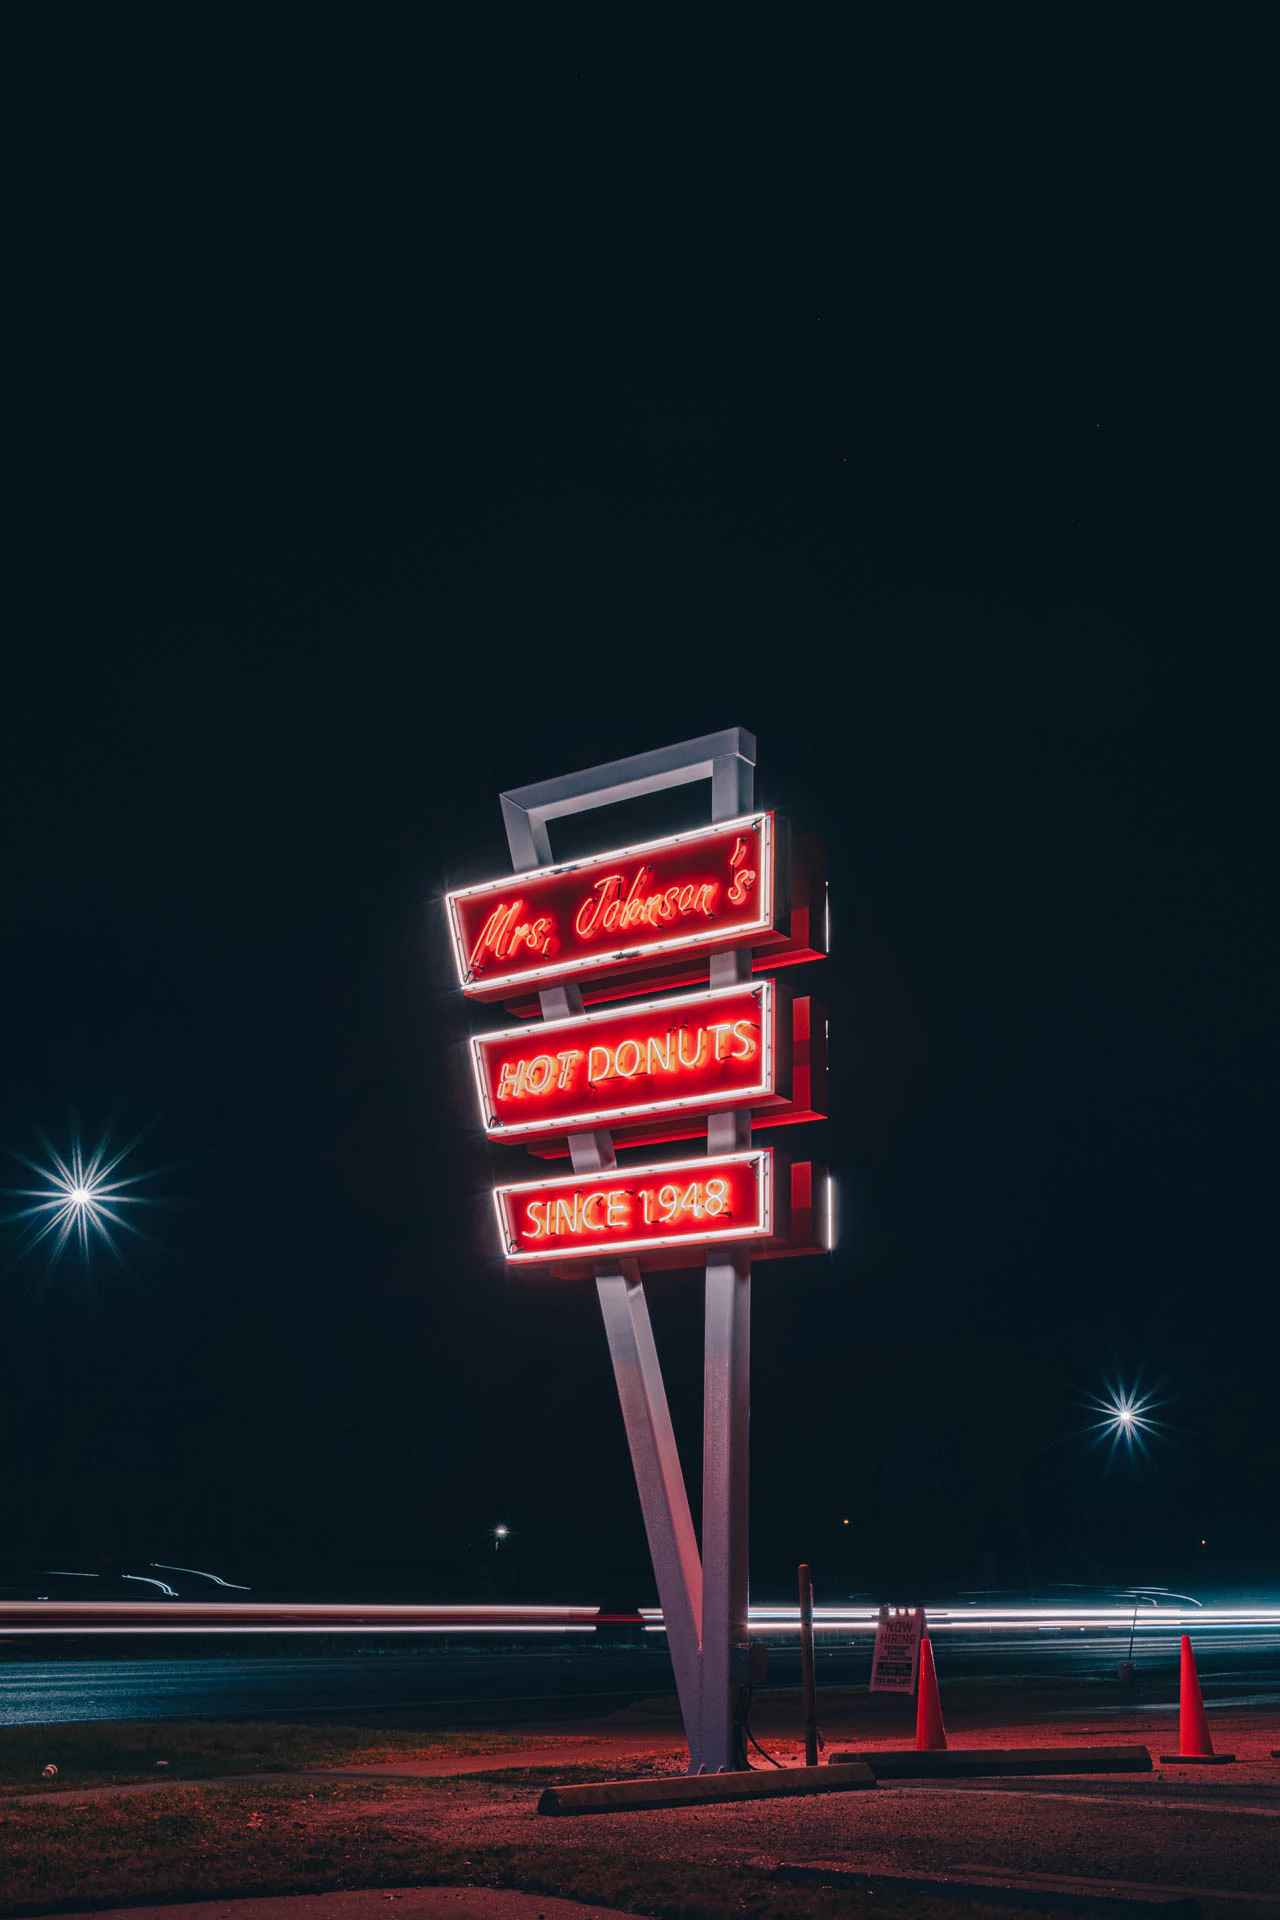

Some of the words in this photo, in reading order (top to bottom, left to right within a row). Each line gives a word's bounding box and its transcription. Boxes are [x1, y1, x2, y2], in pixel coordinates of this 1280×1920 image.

[576, 837, 756, 935] Johnson's
[497, 1050, 579, 1100] HOT
[587, 1020, 755, 1083] DONUTS
[522, 1190, 629, 1238] SINCE
[637, 1178, 729, 1224] 1948
[880, 1633, 916, 1645] HIRING
[885, 1621, 914, 1633] NOW
